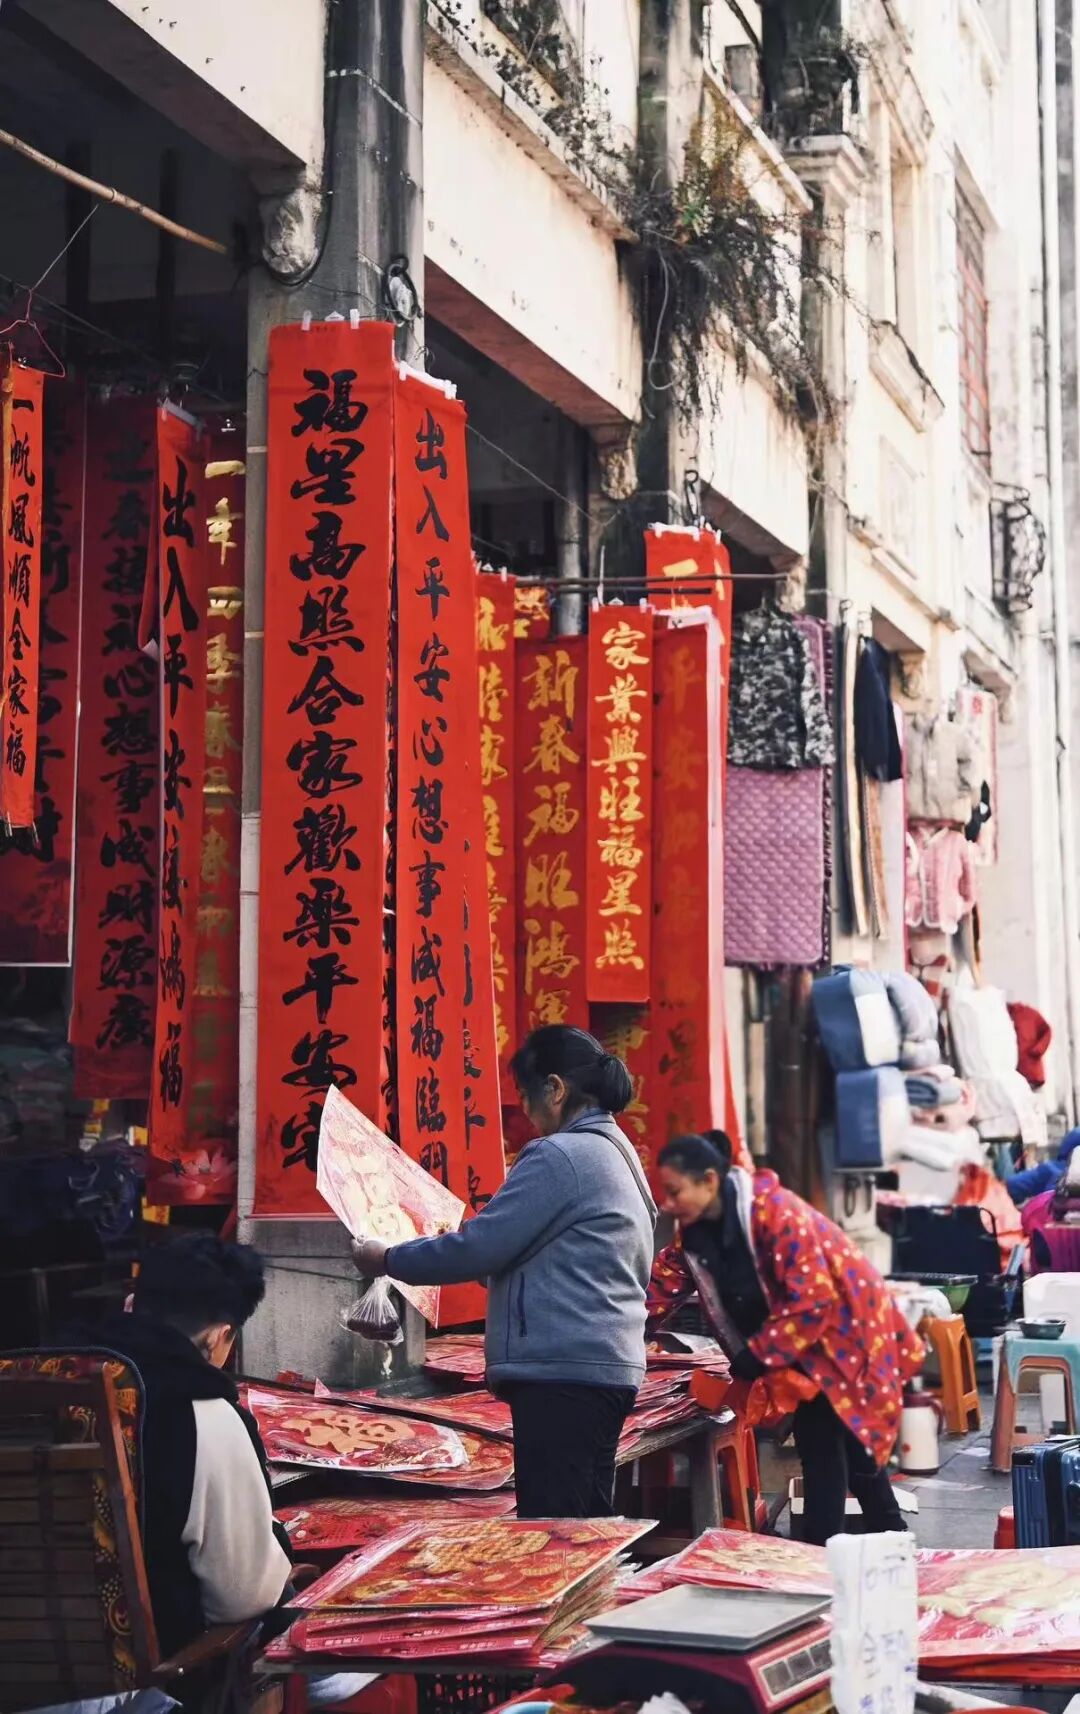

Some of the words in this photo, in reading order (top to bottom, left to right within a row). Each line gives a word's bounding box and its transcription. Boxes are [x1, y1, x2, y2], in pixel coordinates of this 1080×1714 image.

[7, 398, 36, 776] 一帆風順全家福
[592, 620, 651, 971] 家業興旺福星照
